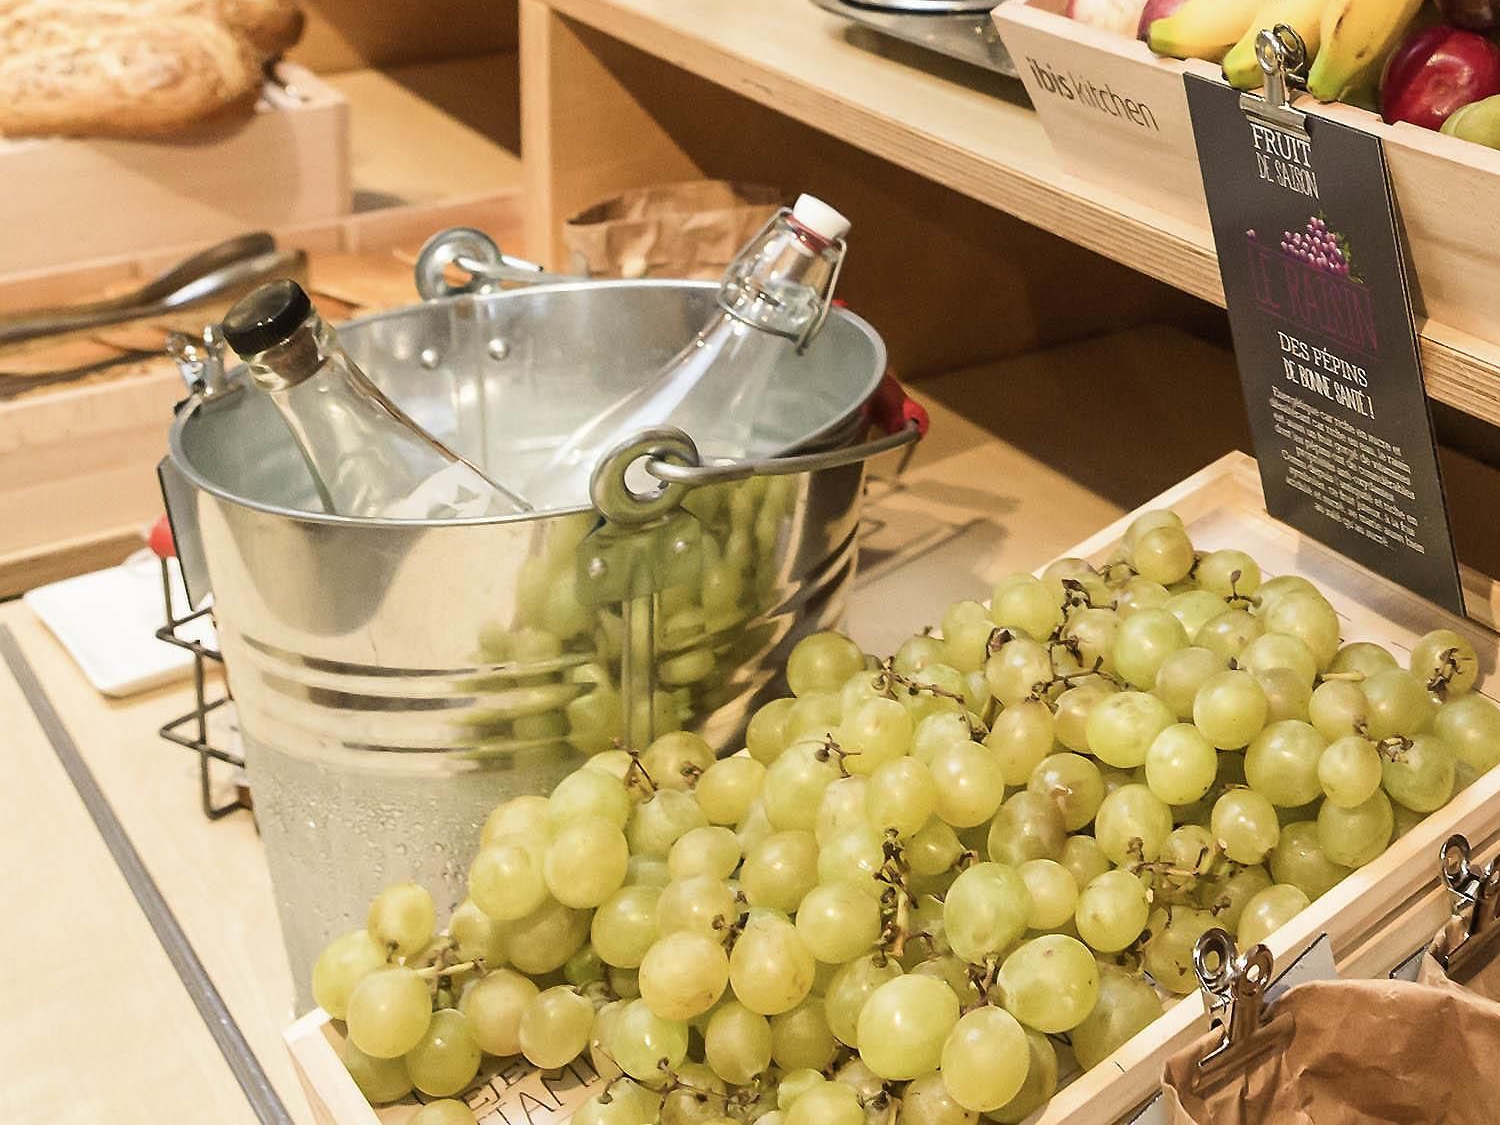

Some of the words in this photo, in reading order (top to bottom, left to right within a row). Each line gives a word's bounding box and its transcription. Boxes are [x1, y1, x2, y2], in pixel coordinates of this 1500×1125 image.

[1025, 56, 1075, 100] ibis
[1067, 71, 1160, 132] kitchen
[1249, 122, 1312, 168] FRUIT
[1255, 151, 1274, 183] DE
[1274, 159, 1320, 201] SAISON
[1277, 330, 1310, 362] DES
[1311, 347, 1368, 388] PÉPINS
[1282, 356, 1300, 385] DE
[1297, 364, 1335, 402] BONNE
